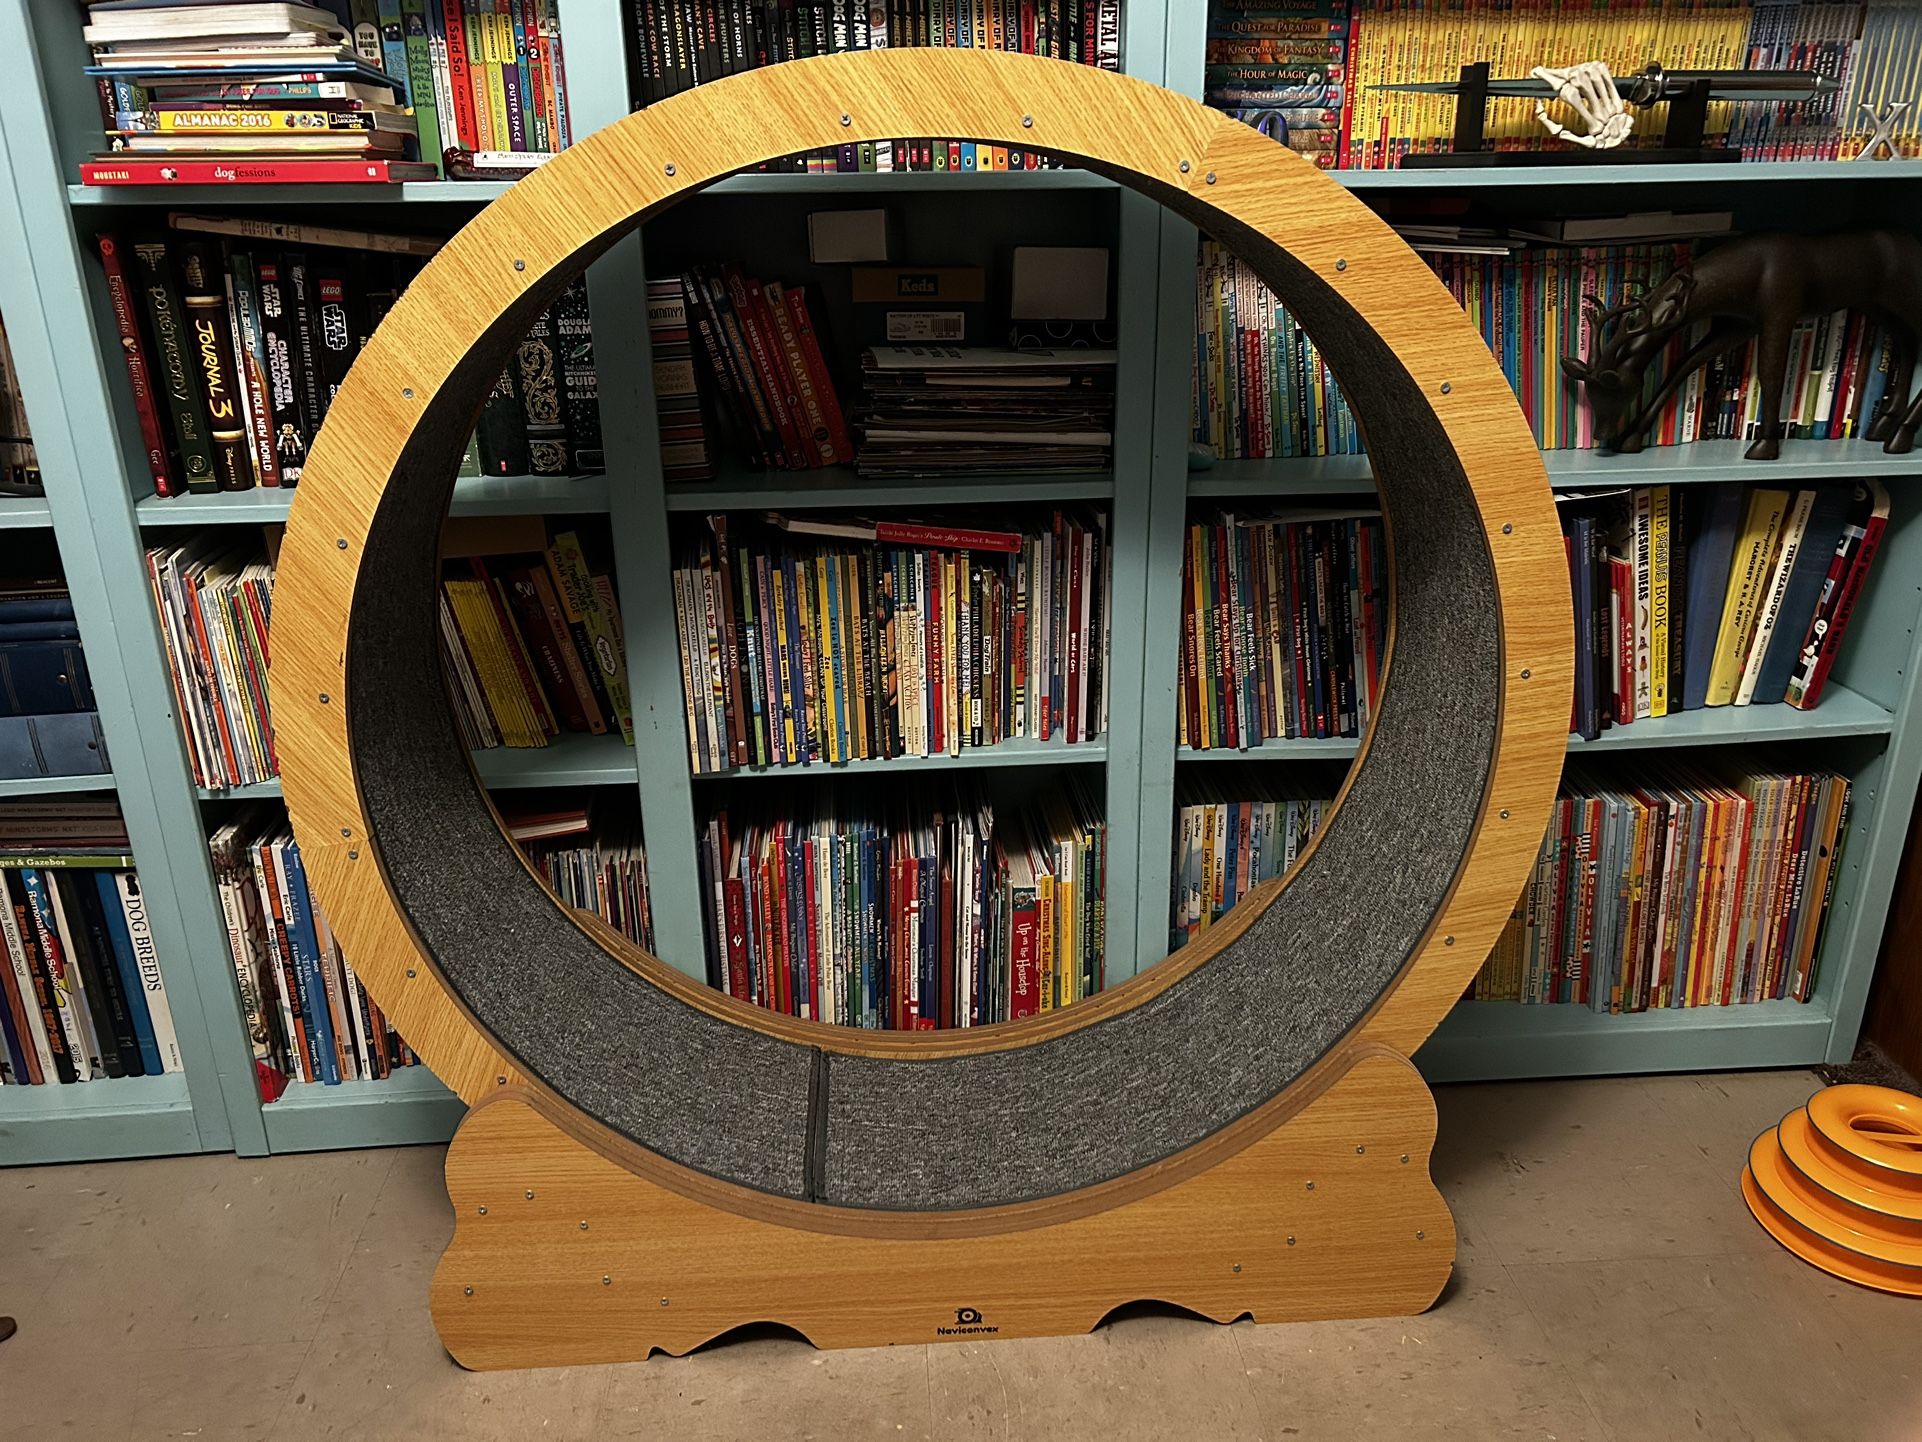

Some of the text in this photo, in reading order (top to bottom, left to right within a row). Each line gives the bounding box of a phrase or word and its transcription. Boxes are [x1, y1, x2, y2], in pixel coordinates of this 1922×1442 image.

[685, 3, 693, 23] JAW
[707, 8, 715, 43] CIRCLES
[814, 7, 827, 45] STITCH
[933, 2, 942, 33] DIARY
[1085, 13, 1094, 35] FOR
[1232, 22, 1319, 32] QUEST PARADISE
[449, 26, 461, 53] Said
[489, 30, 497, 59] JENNINGS
[505, 30, 513, 59] JENNINGS
[661, 14, 671, 67] THE STORM
[697, 27, 705, 50] CAVE
[733, 13, 743, 58] OF HORNS
[834, 23, 847, 47] MAN
[854, 23, 867, 47] MAN
[1228, 45, 1322, 54] KINGDOM FANTASY
[453, 58, 464, 77] So!
[637, 29, 649, 78] BONEVILLE
[650, 30, 660, 79] COW RACE
[1347, 47, 1356, 88] CHRISTMAS
[1240, 69, 1307, 79] HOUR MAGIC
[173, 113, 272, 127] ALMANAC 2016
[460, 102, 469, 136] Jennings
[509, 83, 521, 142] OUTER SPACE
[214, 166, 276, 180] dogfessions
[263, 285, 274, 318] WARS
[270, 284, 282, 317] STAR
[322, 286, 341, 295] LEGO
[902, 279, 935, 291] Keds
[109, 275, 144, 398] Encyclopedia Horrifica
[322, 305, 336, 350] WARS
[333, 310, 347, 350] STAR
[300, 326, 312, 367] ULTIMATE
[195, 319, 234, 418] JOURNAL 3
[266, 332, 285, 411] ENCYCLOPEDIA
[277, 339, 293, 404] CHARACTER
[747, 319, 788, 426] ESSENTIAL HANDBOOK
[774, 307, 823, 426] READY PLAYER ONE
[305, 369, 318, 420] CHARACTER
[251, 381, 272, 471] A HOLE NEW WORLD
[1638, 514, 1649, 601] AWESOME IDEAS
[1655, 494, 1668, 629] THE PEANUTS BOOK
[551, 551, 579, 614] ADAM SAVAGE
[567, 563, 590, 612] Trader Joe's
[1733, 542, 1760, 627] MARGRET REY
[1763, 544, 1796, 631] THE WIZARD OF OZ
[1213, 609, 1221, 627] Bear
[1222, 621, 1230, 640] Says
[729, 645, 737, 669] DOGS
[746, 629, 756, 657] Knut
[854, 637, 860, 646] AT
[863, 641, 869, 650] AT
[1188, 633, 1196, 663] Snores
[972, 662, 980, 698] CHICKENS
[1189, 665, 1196, 677] On
[1207, 658, 1215, 680] More
[1215, 651, 1223, 676] Scared
[864, 672, 872, 696] BEACH
[1203, 848, 1212, 864] Lady
[1250, 847, 1259, 889] Pocahontas
[1203, 880, 1211, 890] the
[1782, 853, 1799, 918] Dear Mrs. LaRue
[1792, 850, 1809, 910] Detective LaRue
[290, 890, 301, 921] FRAZEE
[1043, 899, 1051, 933] CHRISTMAS
[1585, 878, 1594, 936] OLIVIA
[4, 922, 26, 976] Middle School
[28, 890, 61, 990] Ramona Middle School
[126, 899, 161, 991] DOG BREEDS
[766, 934, 774, 975] PADDINGTON
[277, 923, 300, 1014] CREEPY CARROTS!
[295, 964, 303, 984] Rubber
[302, 953, 313, 983] STARS
[1016, 923, 1030, 996] Up on the Housetop
[229, 929, 256, 1030] Dinosaur ENCYCLOPEDIA
[937, 1326, 999, 1335] Naviconvex
